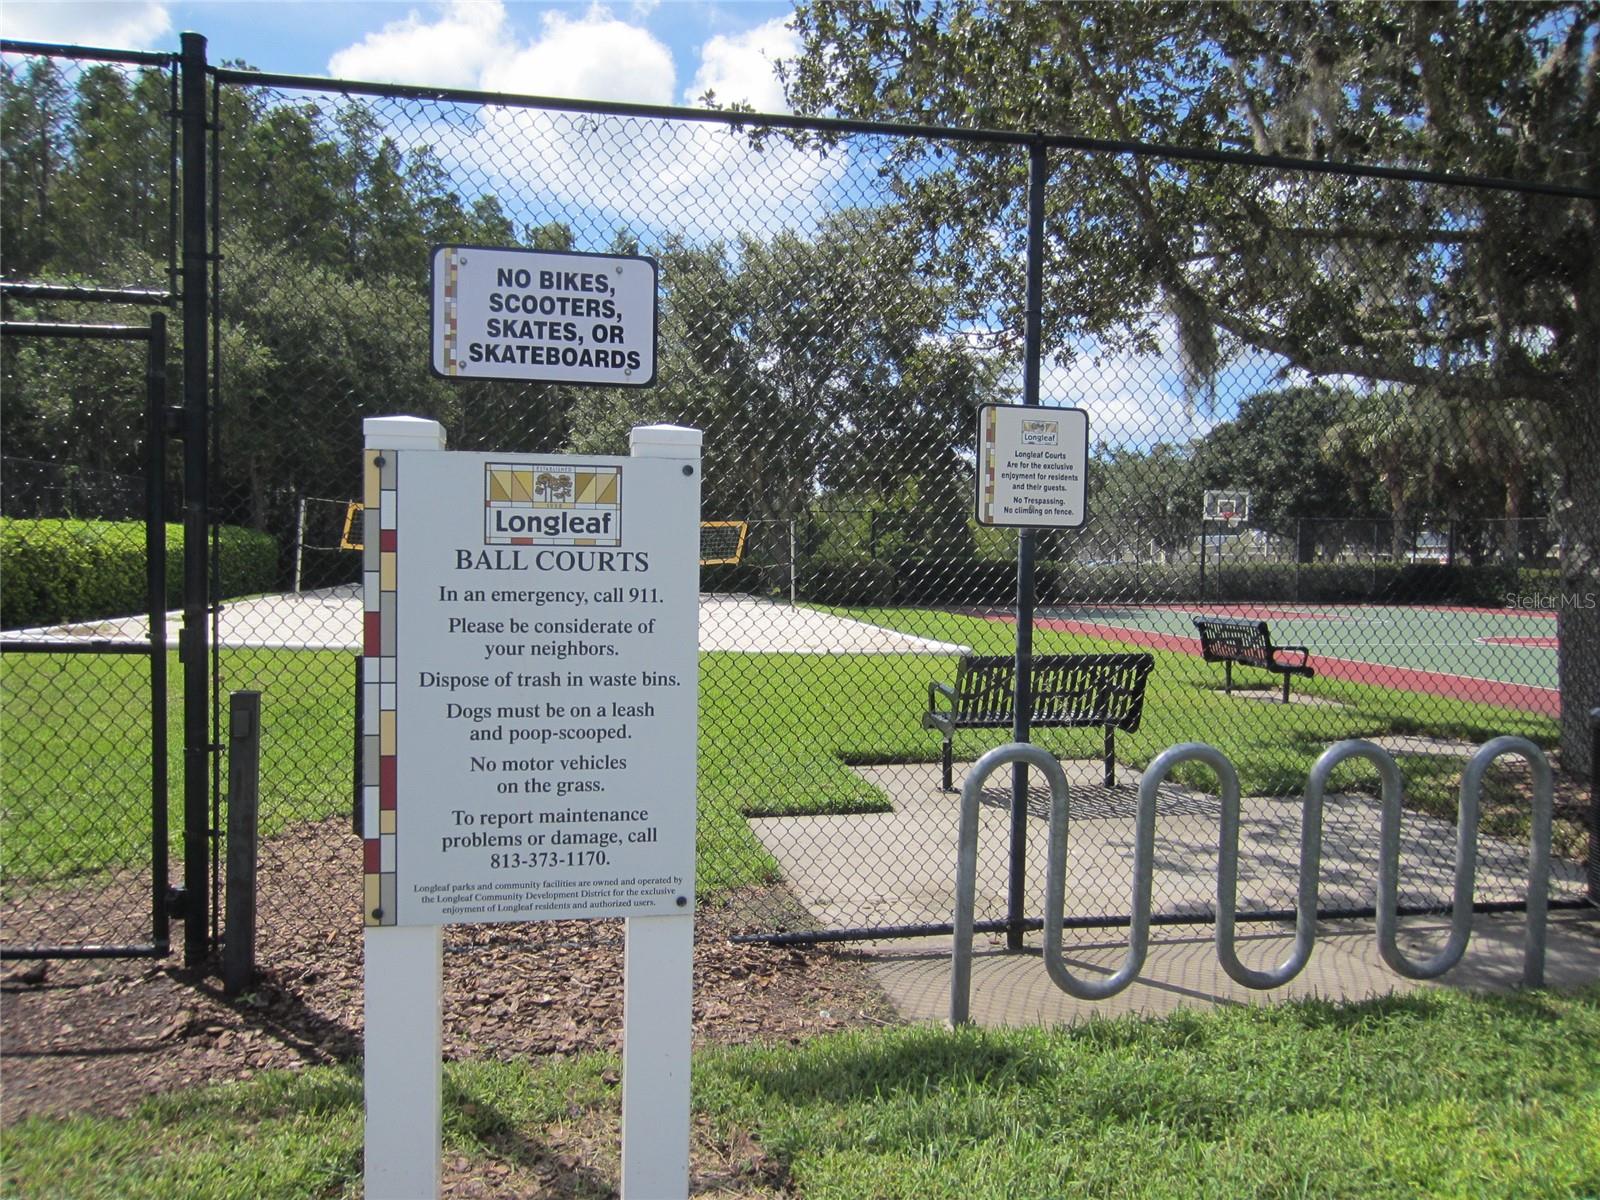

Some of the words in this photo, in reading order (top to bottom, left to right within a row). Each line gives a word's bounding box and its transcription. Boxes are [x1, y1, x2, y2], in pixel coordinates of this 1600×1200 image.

[498, 268, 531, 288] NO
[540, 271, 615, 297] BIKES,
[489, 293, 622, 322] SCOOTERS,
[487, 319, 583, 345] SKATES,
[592, 324, 624, 344] OR
[469, 343, 640, 369] SKATEBOARDS
[1025, 434, 1055, 442] Longleaf
[1015, 451, 1043, 459] Longleaf
[1002, 472, 1035, 481] enjoyment
[1025, 497, 1065, 505] Trespassing.
[1015, 507, 1042, 515] climbing
[497, 510, 611, 536] Longleaf
[456, 550, 528, 570] BALL
[536, 551, 648, 572] COURTS
[440, 586, 457, 601] In
[464, 591, 485, 601] an
[491, 588, 588, 606] emergency,
[594, 588, 623, 602] call
[629, 588, 663, 603] 911.
[449, 618, 504, 633] Please
[510, 618, 528, 633] be
[535, 619, 632, 633] considerate
[638, 619, 656, 633] of
[485, 645, 525, 659] your
[531, 641, 618, 659] neighbors.
[420, 672, 489, 691] Dispose
[495, 672, 513, 687] of
[518, 672, 560, 686] trash
[568, 672, 582, 686] in
[590, 673, 636, 686] waste
[642, 672, 680, 686] bins.
[447, 704, 491, 722] Dogs
[498, 705, 539, 718] must
[546, 703, 564, 717] be
[570, 707, 590, 717] on
[597, 707, 606, 717] a
[613, 702, 654, 717] leash
[470, 725, 502, 740] and
[510, 724, 631, 744] poop-scooped.
[471, 757, 496, 771] No
[503, 758, 554, 771] motor
[560, 755, 626, 770] vehicles
[497, 783, 517, 793] on
[525, 778, 551, 793] the
[557, 781, 604, 796] grass.
[452, 811, 474, 825] To
[480, 811, 533, 828] report
[540, 808, 648, 823] maintenance
[442, 831, 522, 851] problems
[528, 835, 545, 845] or
[551, 830, 622, 847] damage,
[628, 828, 656, 842] call
[491, 851, 610, 868] 813-373-1170.
[414, 884, 450, 893] Longleaf
[452, 884, 475, 892] parks
[477, 883, 492, 891] and
[495, 881, 540, 891] community
[542, 879, 576, 888] facilities
[578, 879, 591, 887] are
[593, 878, 618, 886] owned
[621, 877, 635, 885] and
[638, 876, 671, 886] operated
[673, 876, 682, 885] by
[422, 895, 435, 903] the
[437, 894, 473, 903] Longleaf
[475, 892, 523, 902] Community
[526, 890, 579, 901] Development
[581, 889, 610, 897] District
[612, 888, 624, 896] for
[641, 886, 675, 895] exclusive
[442, 906, 485, 915] enjoyment
[497, 903, 533, 913] Longleaf
[535, 901, 571, 910] residents
[572, 901, 587, 909] and
[590, 900, 632, 908] authorized
[634, 898, 655, 907] users.
